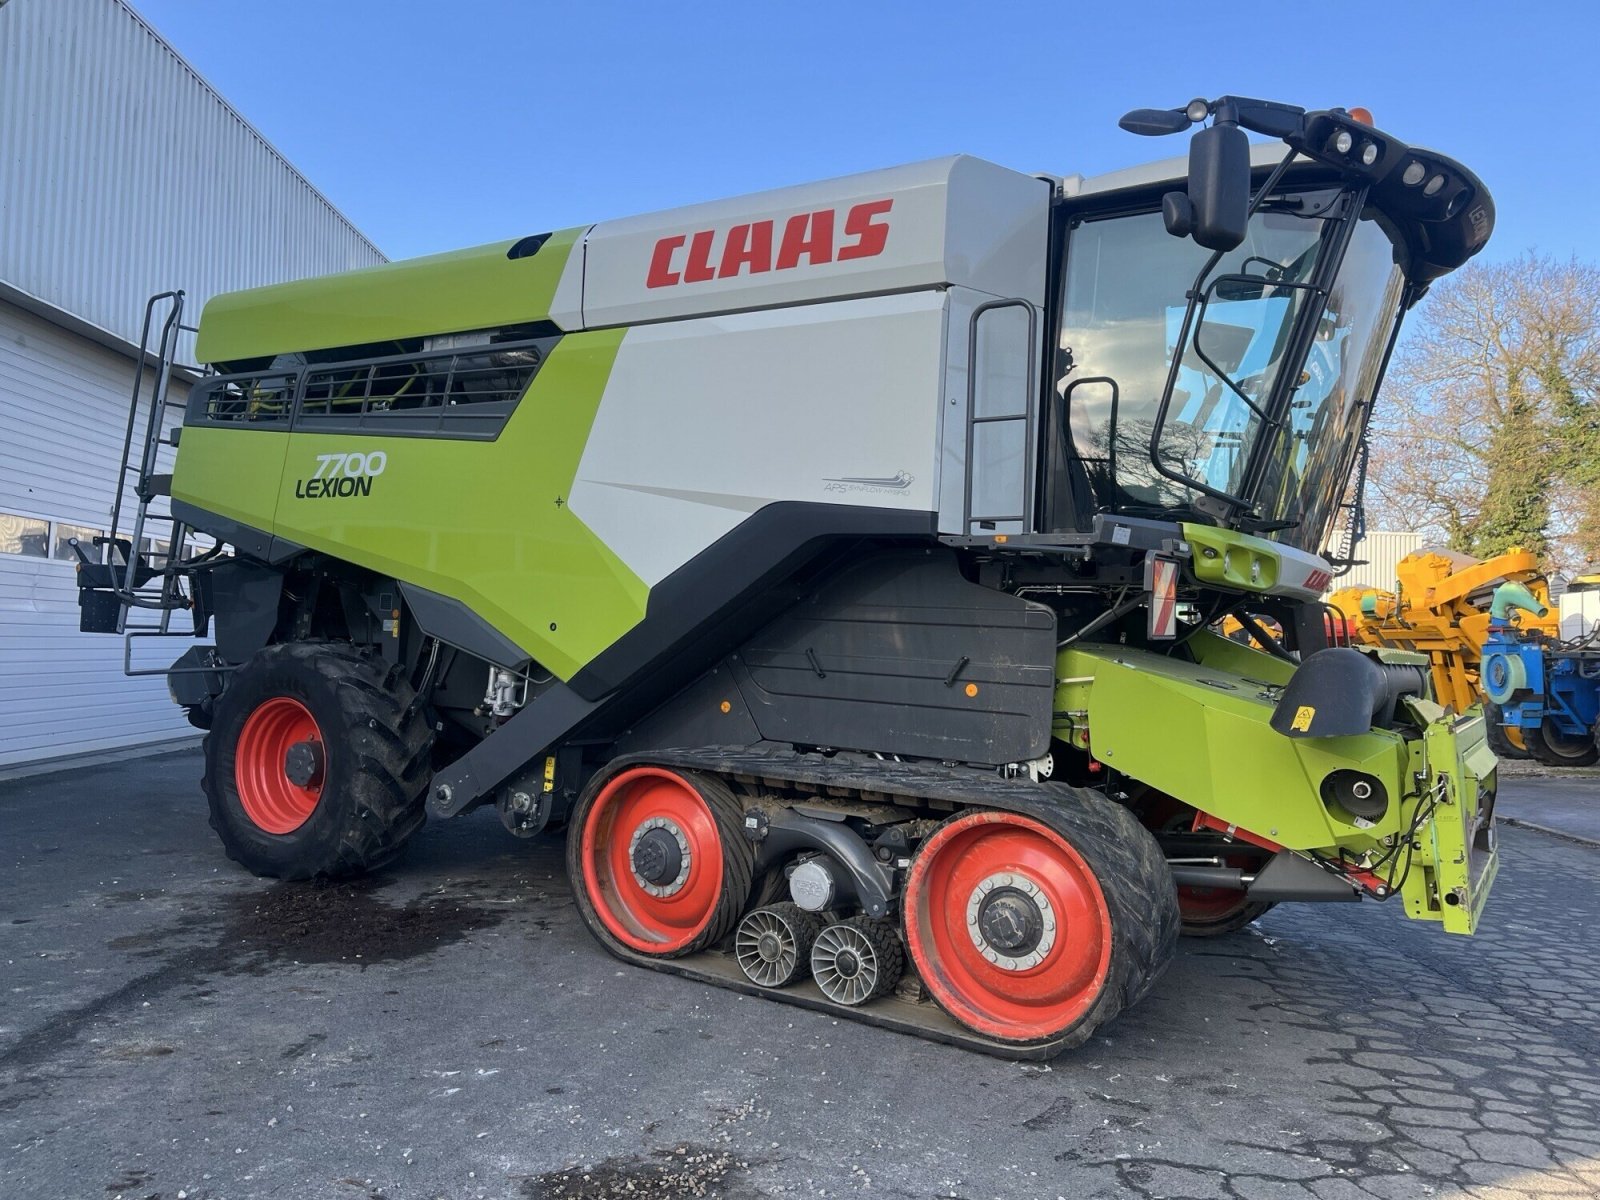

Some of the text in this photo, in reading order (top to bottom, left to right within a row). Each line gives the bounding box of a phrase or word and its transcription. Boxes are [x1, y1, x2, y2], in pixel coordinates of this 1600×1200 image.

[646, 198, 894, 289] CLAAS
[312, 451, 387, 480] 7700
[295, 475, 373, 499] LEXION
[823, 482, 849, 494] APS
